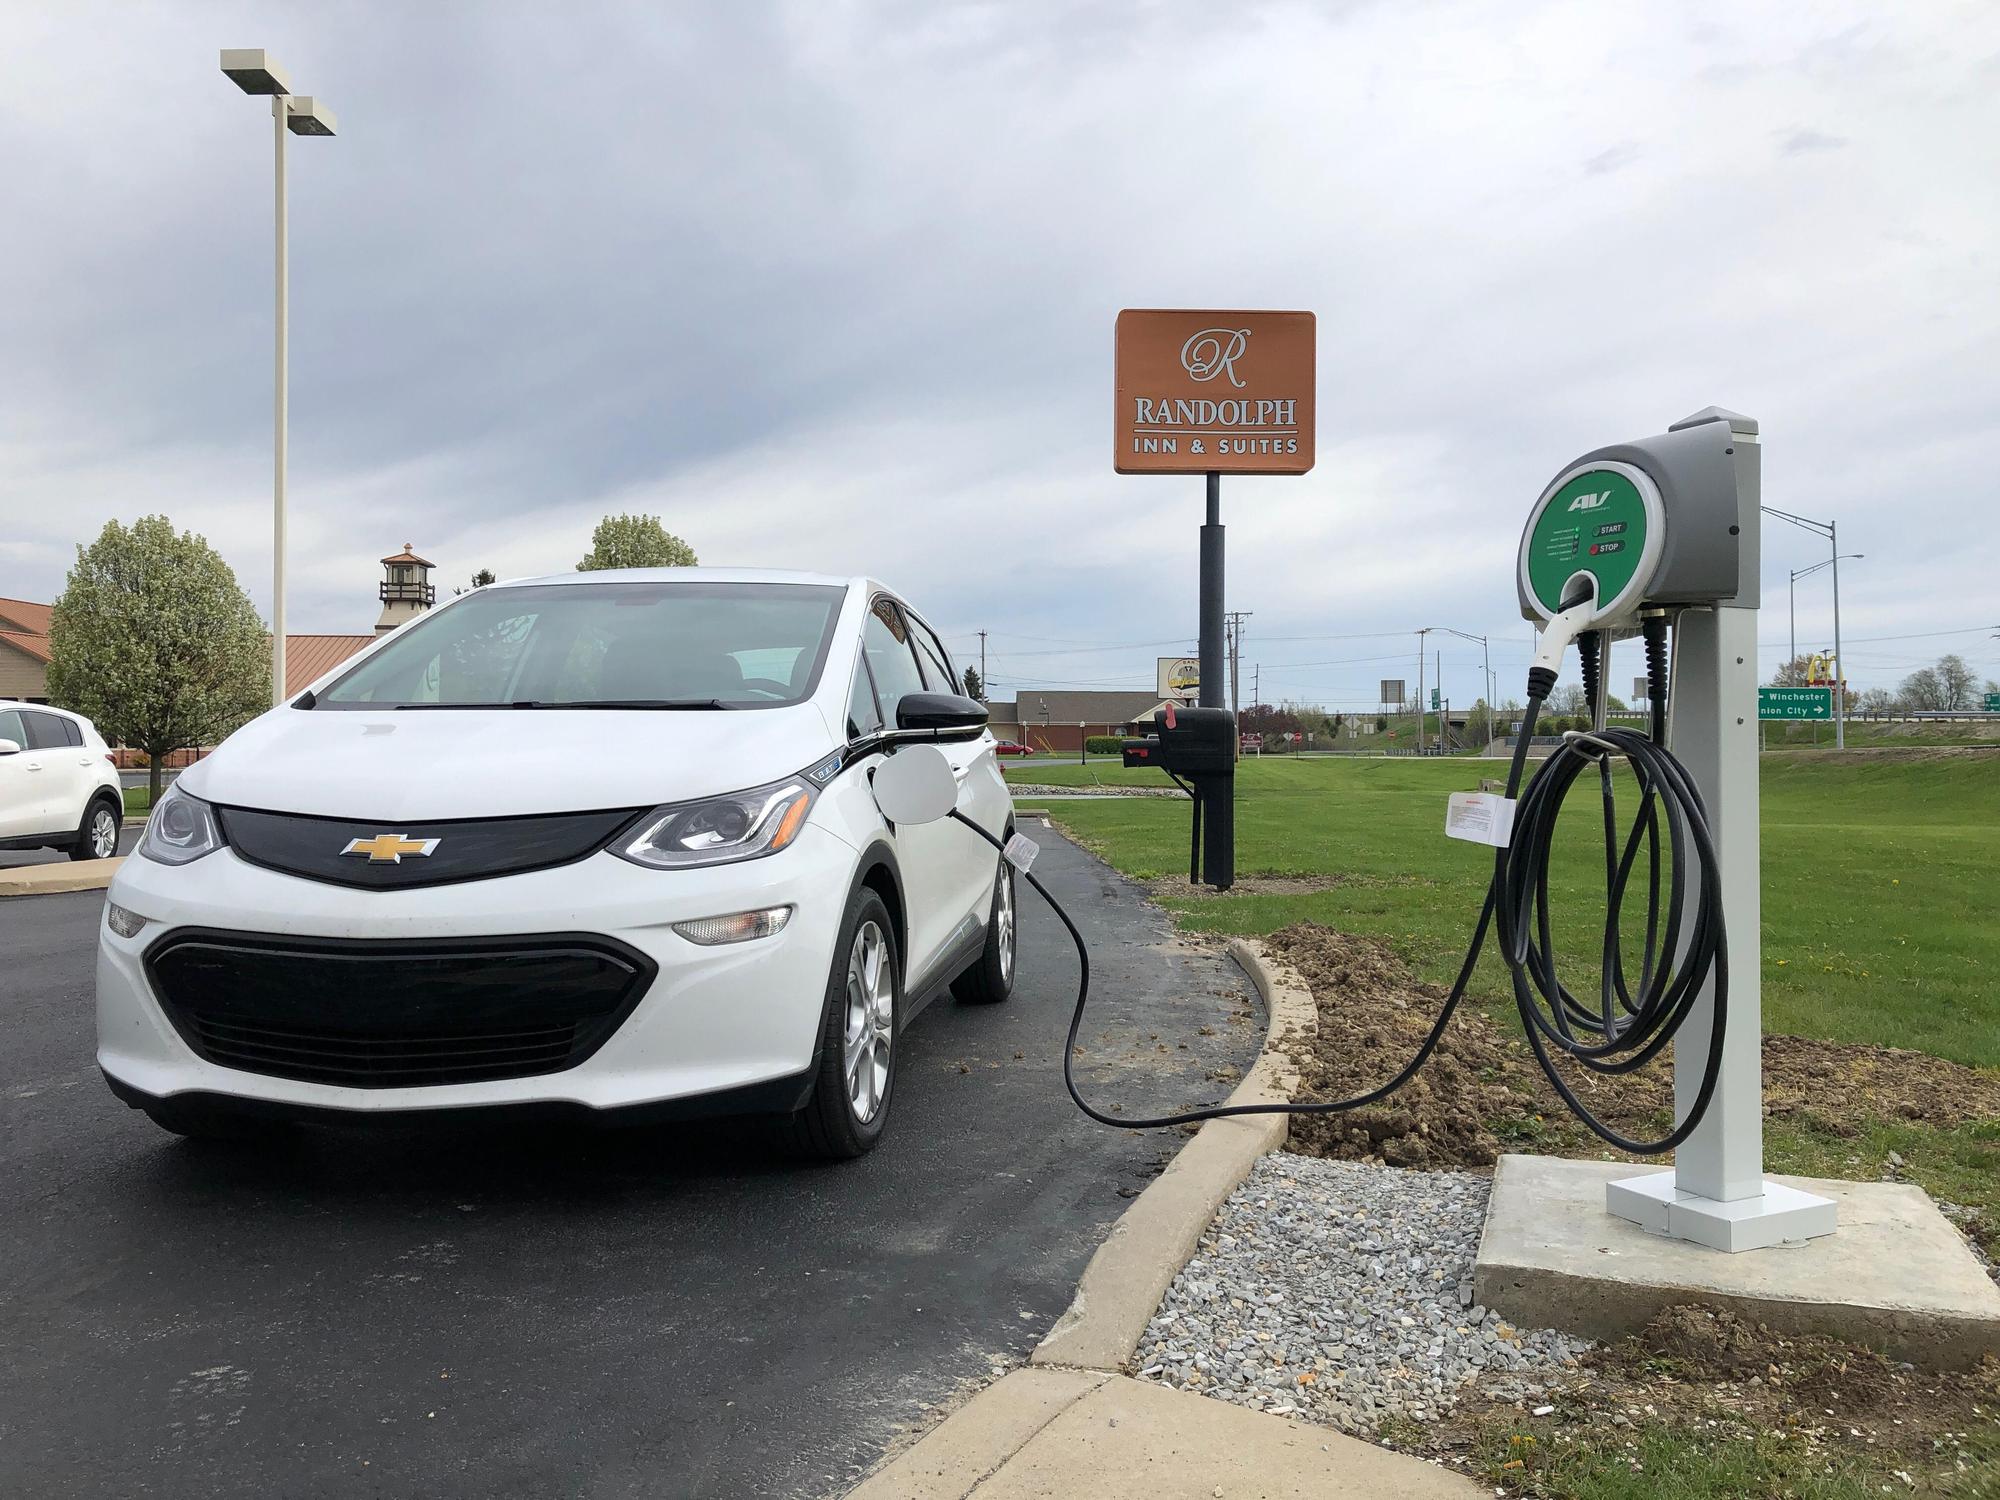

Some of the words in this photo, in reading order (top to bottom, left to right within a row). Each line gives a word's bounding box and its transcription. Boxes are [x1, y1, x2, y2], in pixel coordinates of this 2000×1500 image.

[1181, 328, 1252, 388] R
[1134, 397, 1297, 426] RANDOLPH
[1133, 438, 1177, 454] INN
[1190, 438, 1206, 454] &
[1218, 438, 1298, 454] SUITES
[1601, 524, 1622, 534] START
[1599, 543, 1619, 553] STOP
[1769, 693, 1825, 701] Winchester
[1760, 706, 1782, 714] nion
[1787, 706, 1808, 717] City
